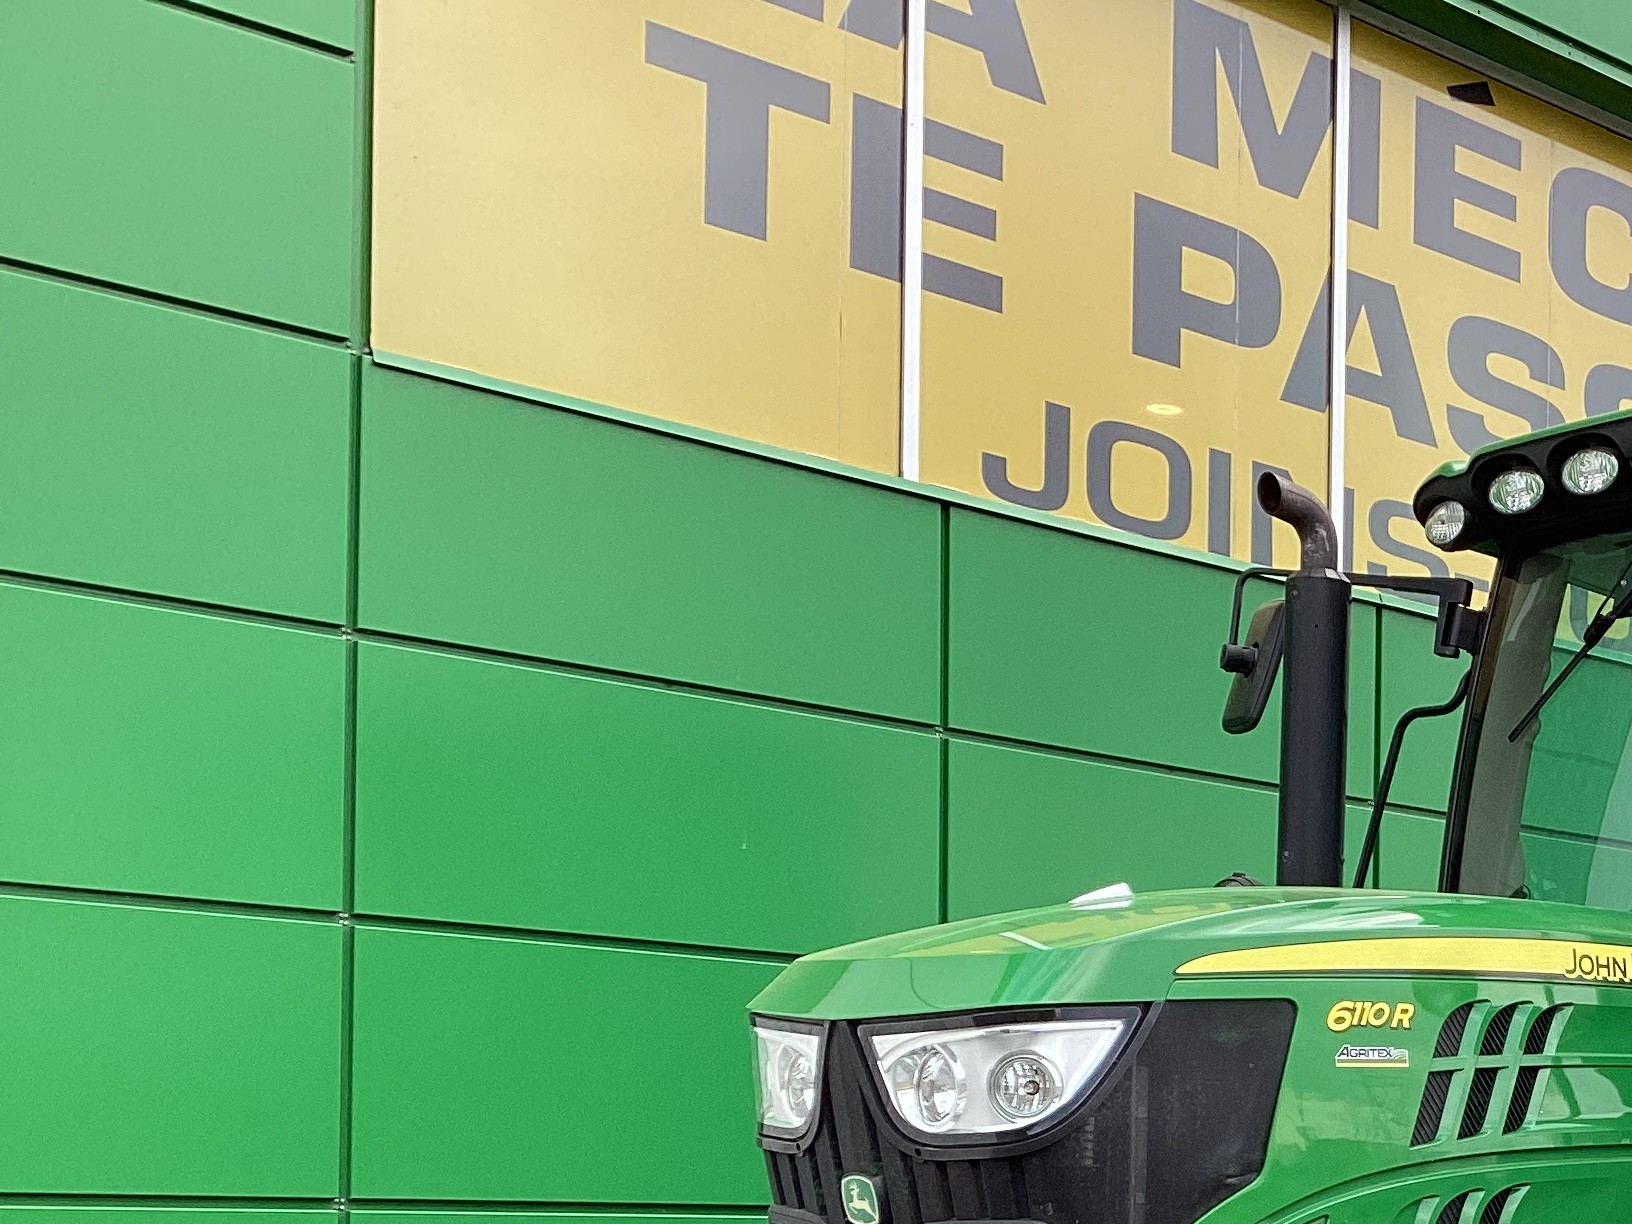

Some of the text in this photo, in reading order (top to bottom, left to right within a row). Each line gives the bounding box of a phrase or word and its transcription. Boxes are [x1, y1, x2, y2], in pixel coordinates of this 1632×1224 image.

[645, 20, 1004, 314] TE
[1565, 948, 1627, 979] JOHN
[1337, 1046, 1393, 1059] AGRITEX
